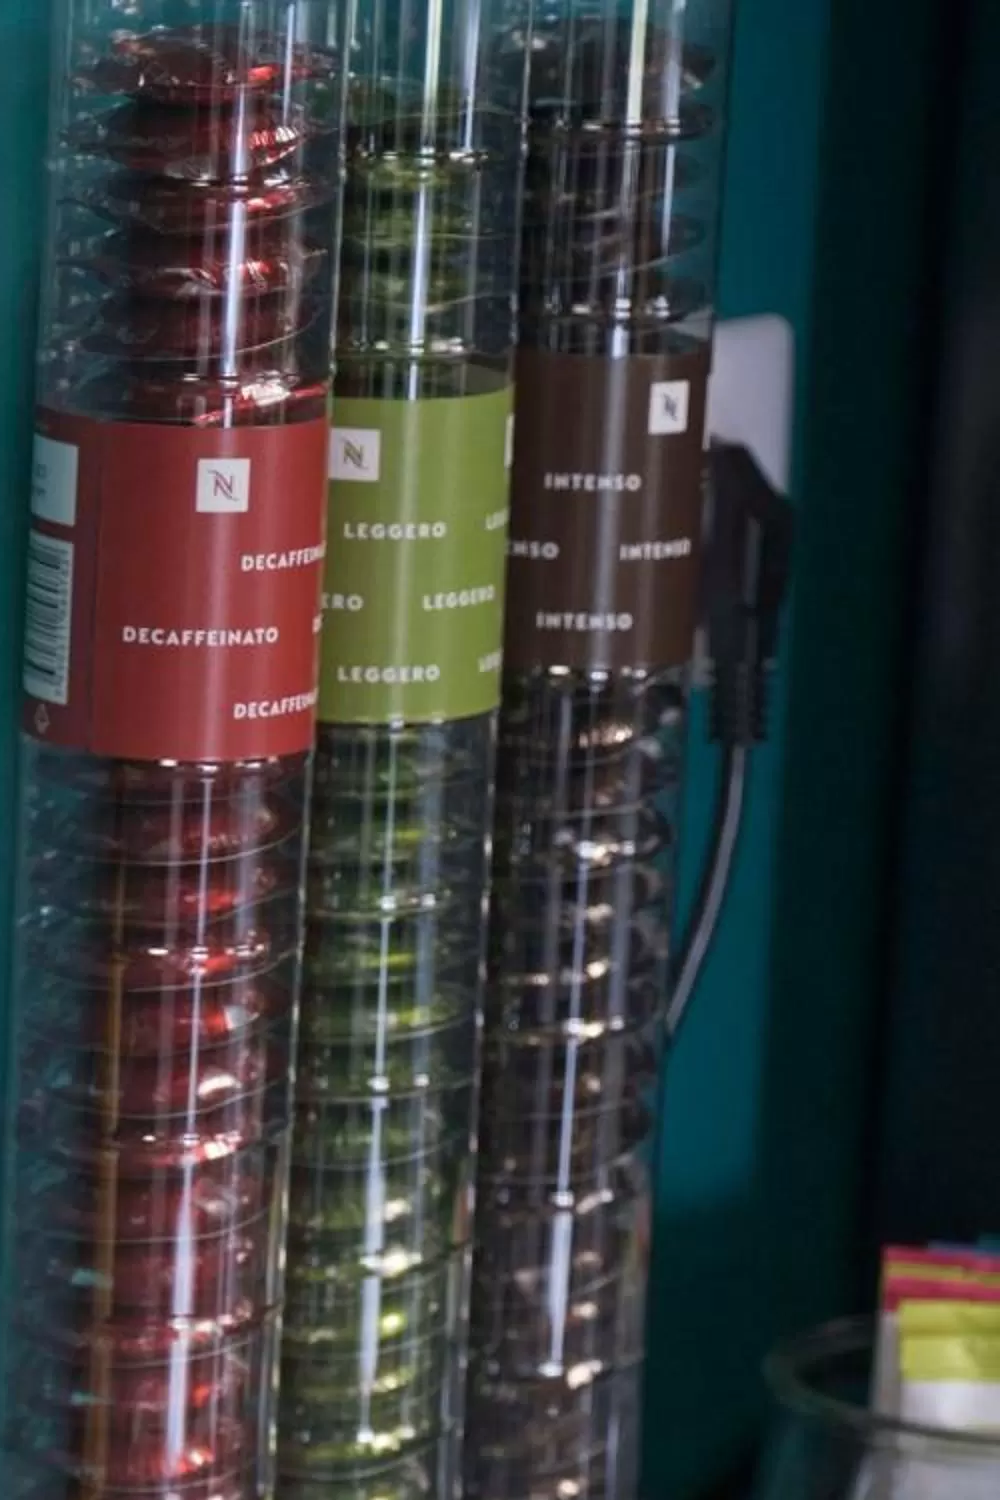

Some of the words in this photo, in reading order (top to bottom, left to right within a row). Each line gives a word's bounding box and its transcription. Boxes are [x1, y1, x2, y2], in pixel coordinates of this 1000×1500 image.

[544, 473, 642, 492] INTENSO
[343, 521, 447, 541] LEGGERO
[422, 584, 496, 612] LEGGERO
[536, 611, 633, 631] INTENSO
[122, 624, 279, 647] DECAFFEINATO
[337, 663, 441, 683] LEGGERO
